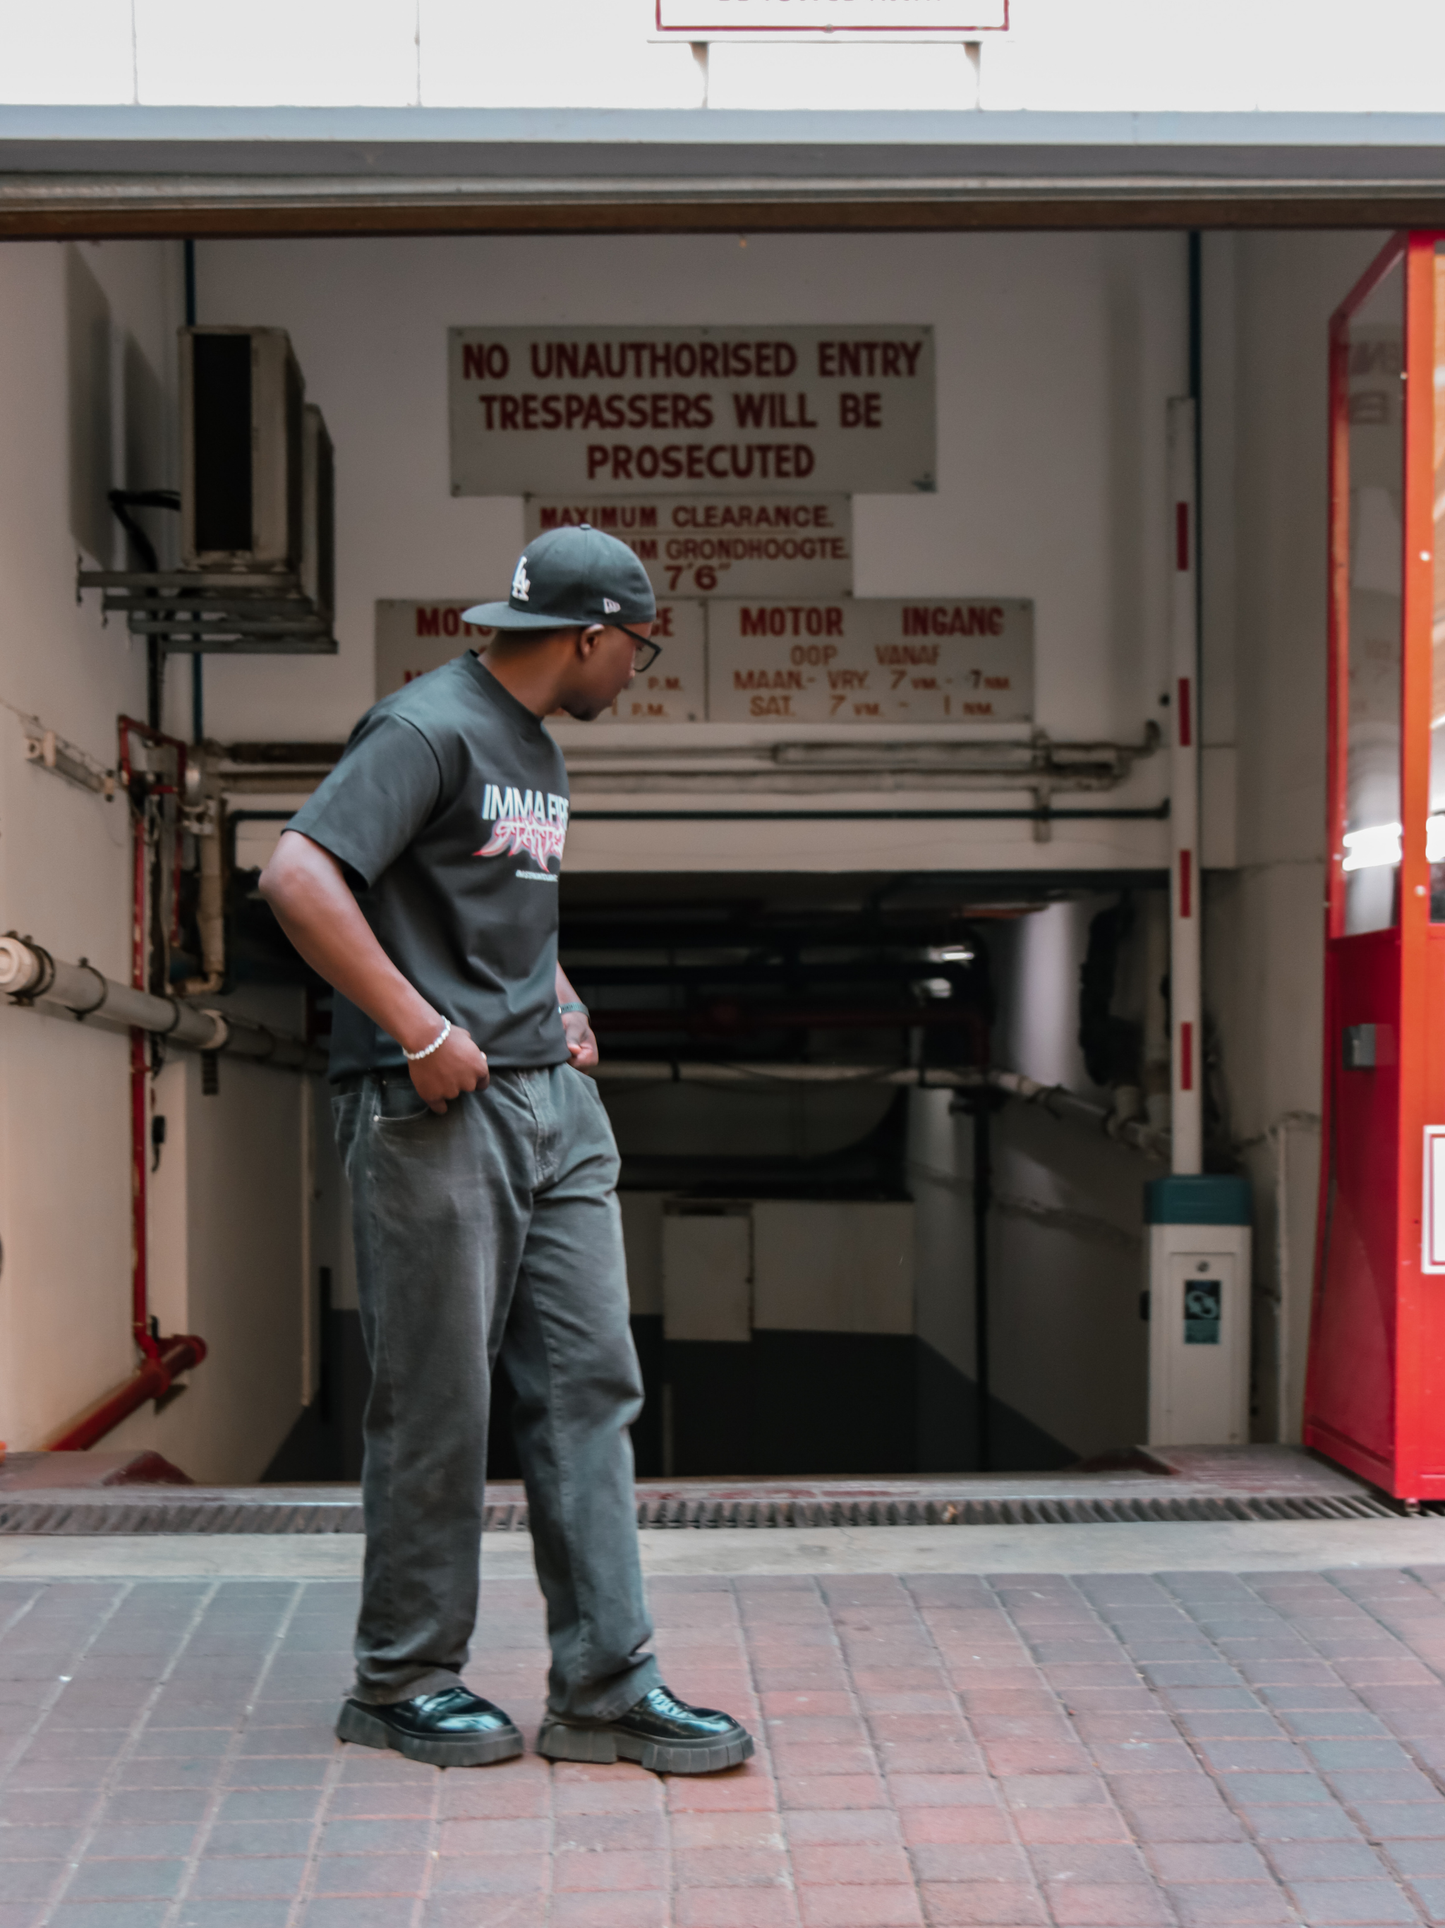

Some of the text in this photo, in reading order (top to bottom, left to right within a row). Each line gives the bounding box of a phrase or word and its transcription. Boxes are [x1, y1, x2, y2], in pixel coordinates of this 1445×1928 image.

[463, 341, 922, 379] NO UNAUTHORISED ENTRY
[479, 392, 882, 430] TRESPASSERS WILL BE
[587, 444, 814, 479] PROSECUTED
[540, 506, 657, 528] MAXIMUM
[740, 606, 844, 636] MOTOR
[790, 644, 838, 666] OOP
[891, 669, 907, 689] 7
[830, 695, 847, 717] 7
